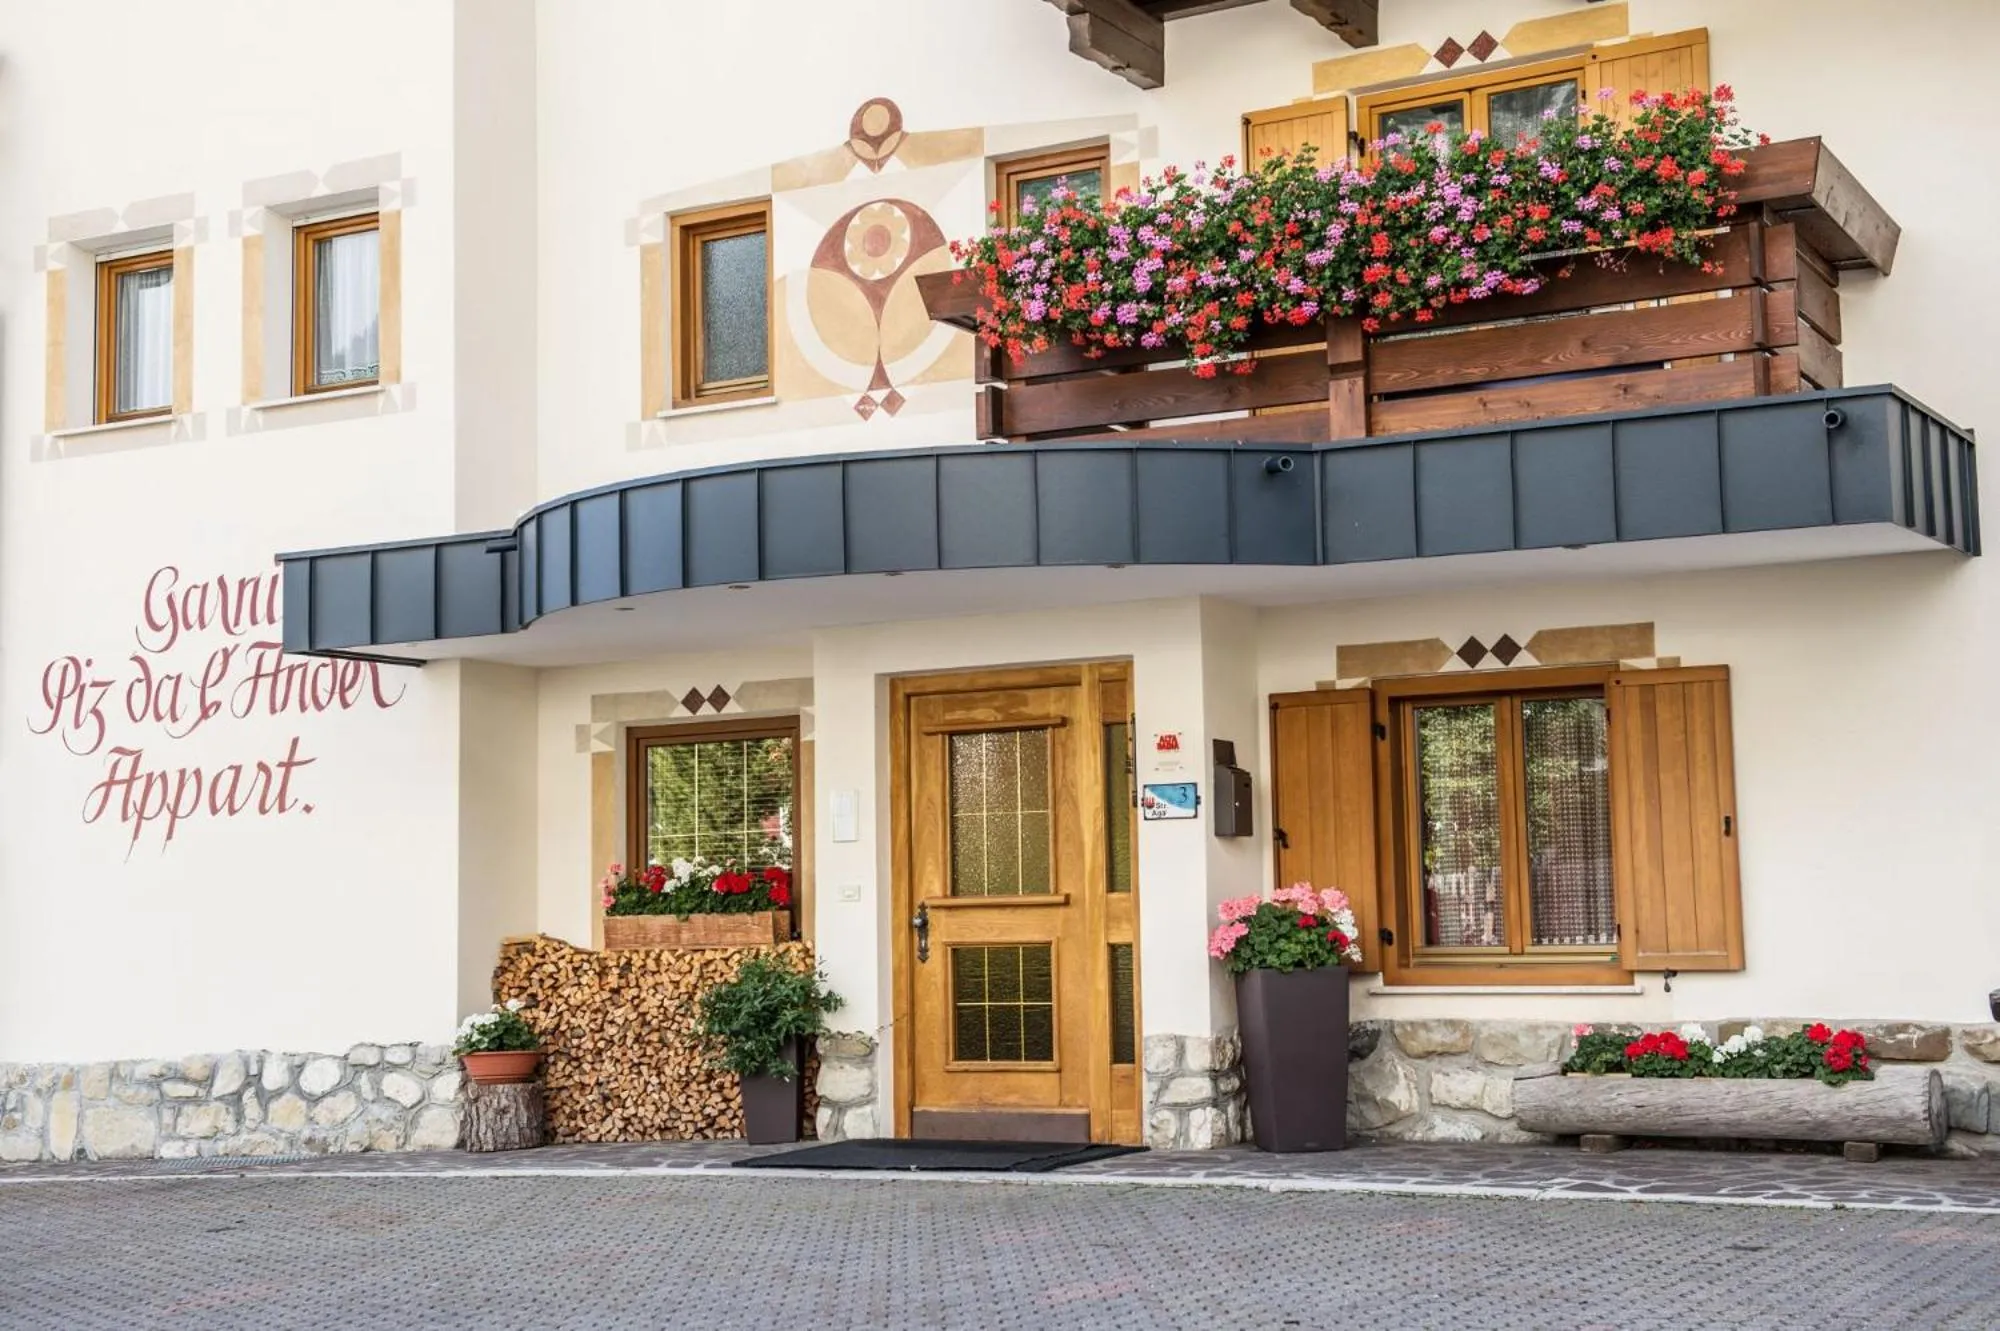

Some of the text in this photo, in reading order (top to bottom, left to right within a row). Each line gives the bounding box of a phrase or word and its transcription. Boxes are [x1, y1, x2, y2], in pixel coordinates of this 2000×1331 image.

[136, 566, 281, 653] Garni
[27, 656, 116, 756] Piz
[126, 655, 188, 724] da
[82, 736, 318, 864] Appart.
[1176, 786, 1188, 804] 3
